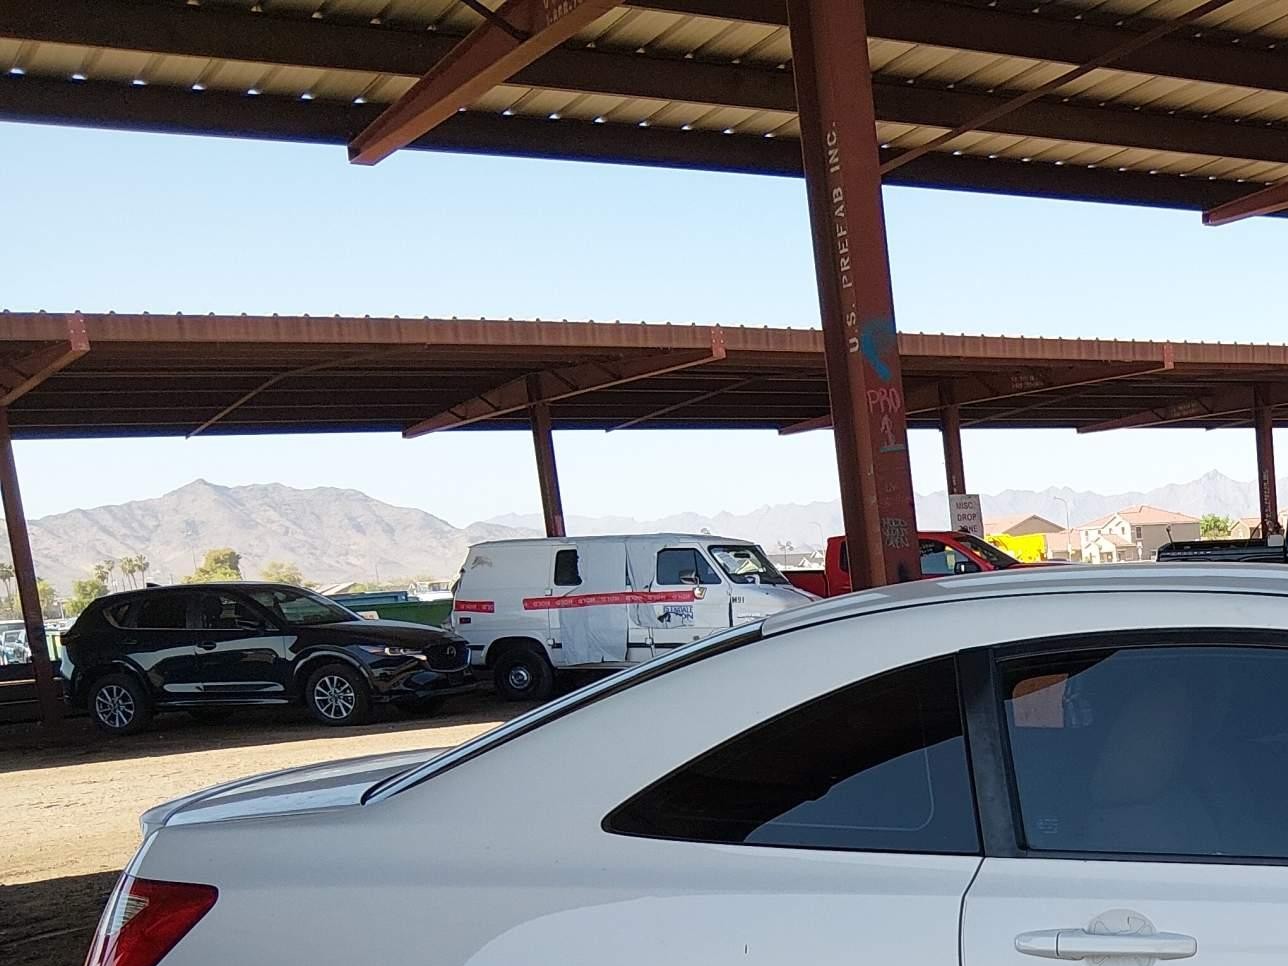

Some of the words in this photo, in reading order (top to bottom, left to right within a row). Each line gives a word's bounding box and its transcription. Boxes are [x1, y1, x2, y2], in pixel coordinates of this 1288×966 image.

[827, 121, 840, 172] INC.
[832, 186, 852, 288] PREFAB
[867, 388, 901, 413] PRO
[957, 513, 977, 522] DROP
